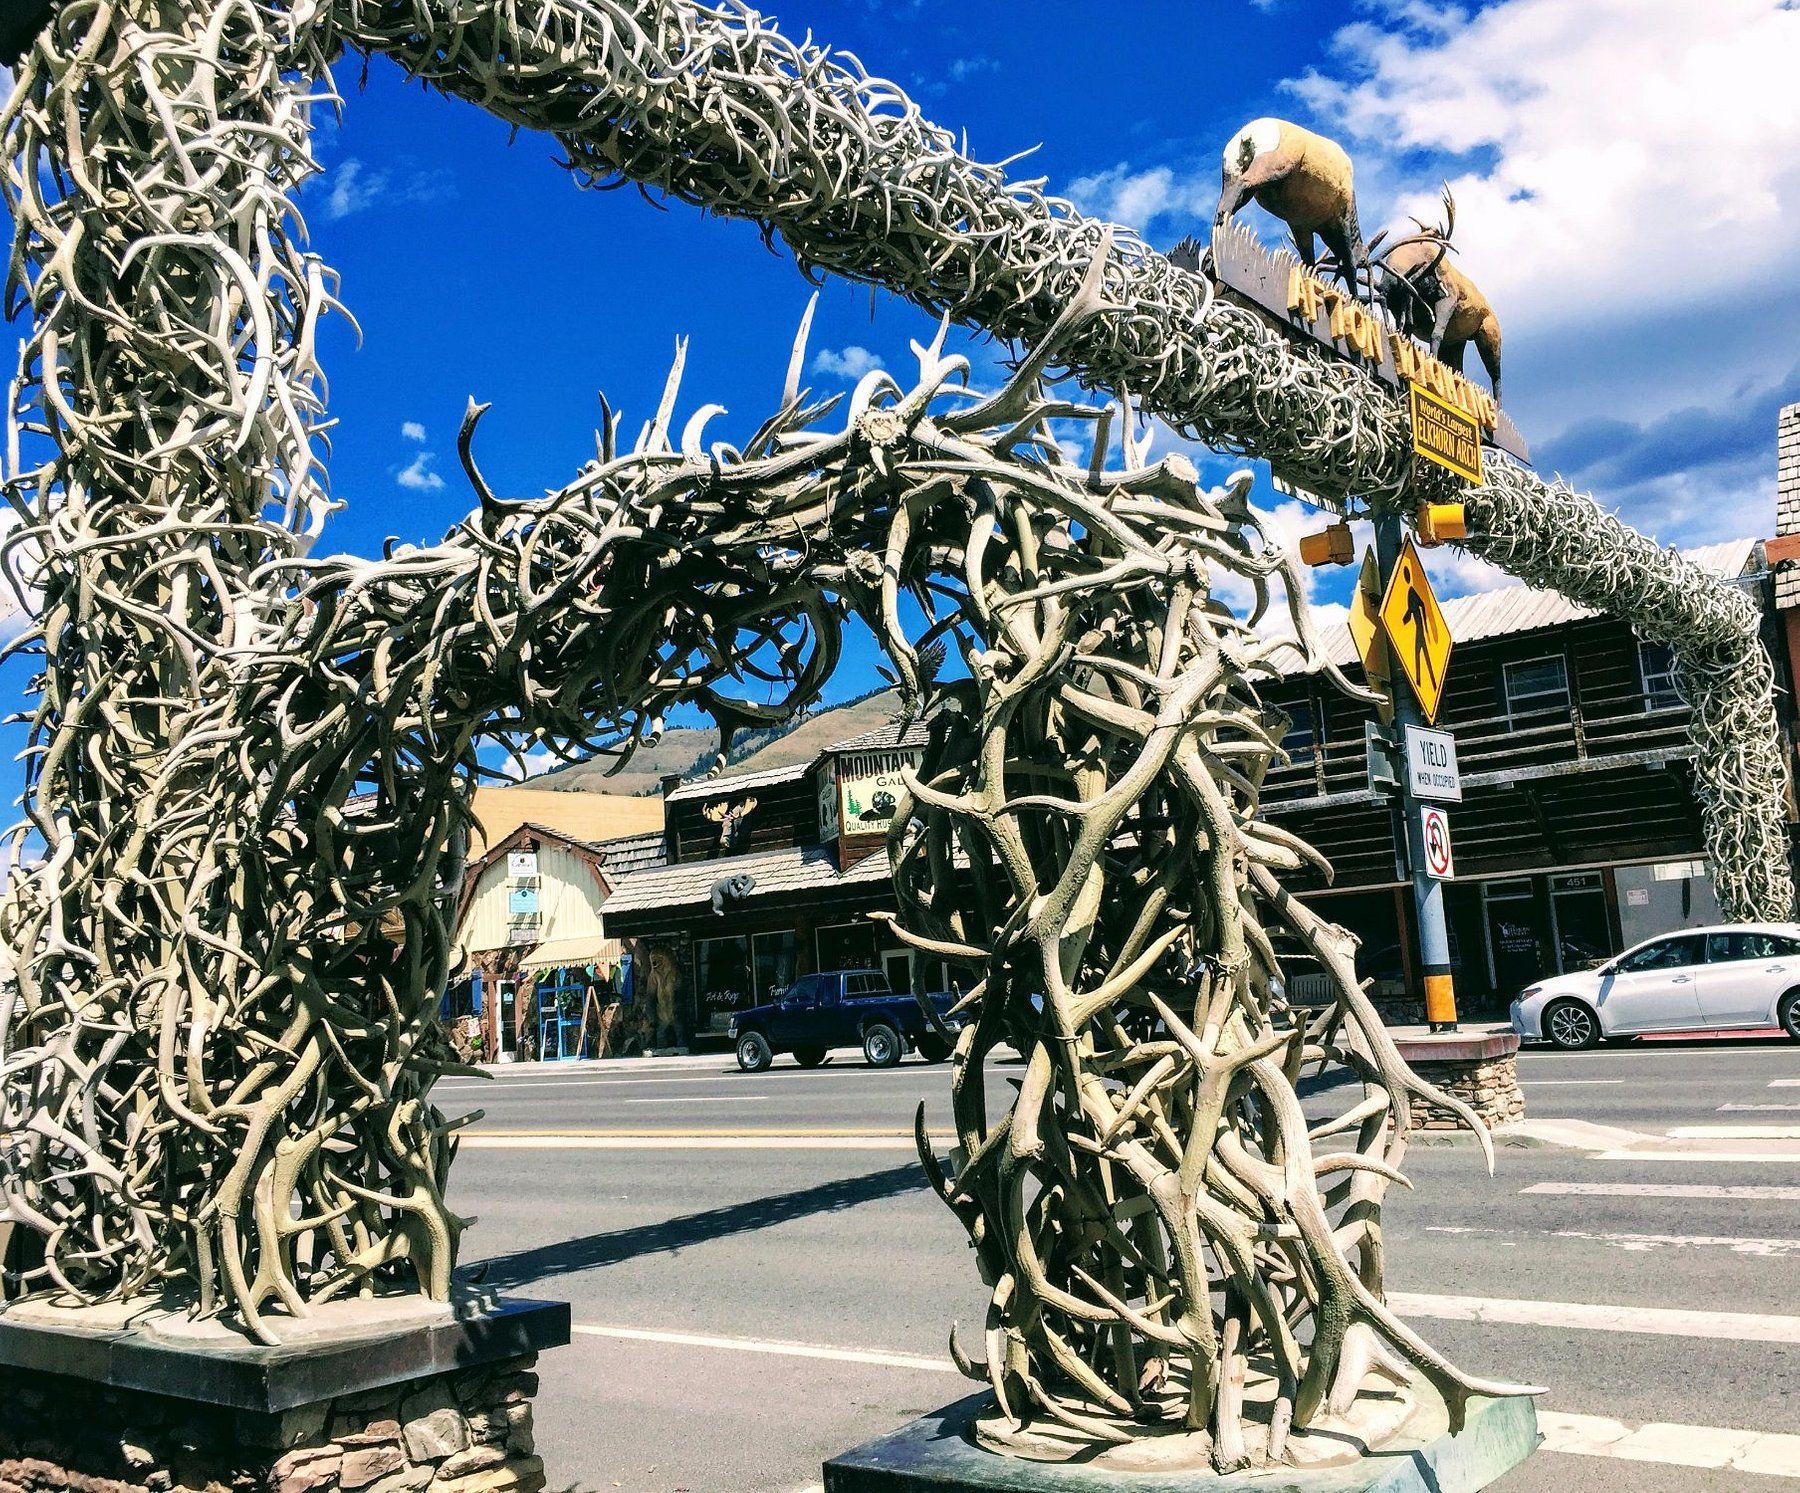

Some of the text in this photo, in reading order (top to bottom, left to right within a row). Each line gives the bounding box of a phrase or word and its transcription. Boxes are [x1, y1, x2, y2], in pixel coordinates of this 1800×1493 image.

[1287, 266, 1383, 365] AFTON
[1420, 398, 1473, 439] World's Largest
[1418, 417, 1477, 470] ELKHORN ARCH
[841, 751, 916, 783] MOUNTAIN
[1420, 740, 1447, 767] YIELD
[876, 776, 904, 787] GAL
[1417, 772, 1455, 788] WHEN OCCUPIED
[845, 819, 891, 832] QUALITY RUS
[1567, 877, 1585, 886] 451
